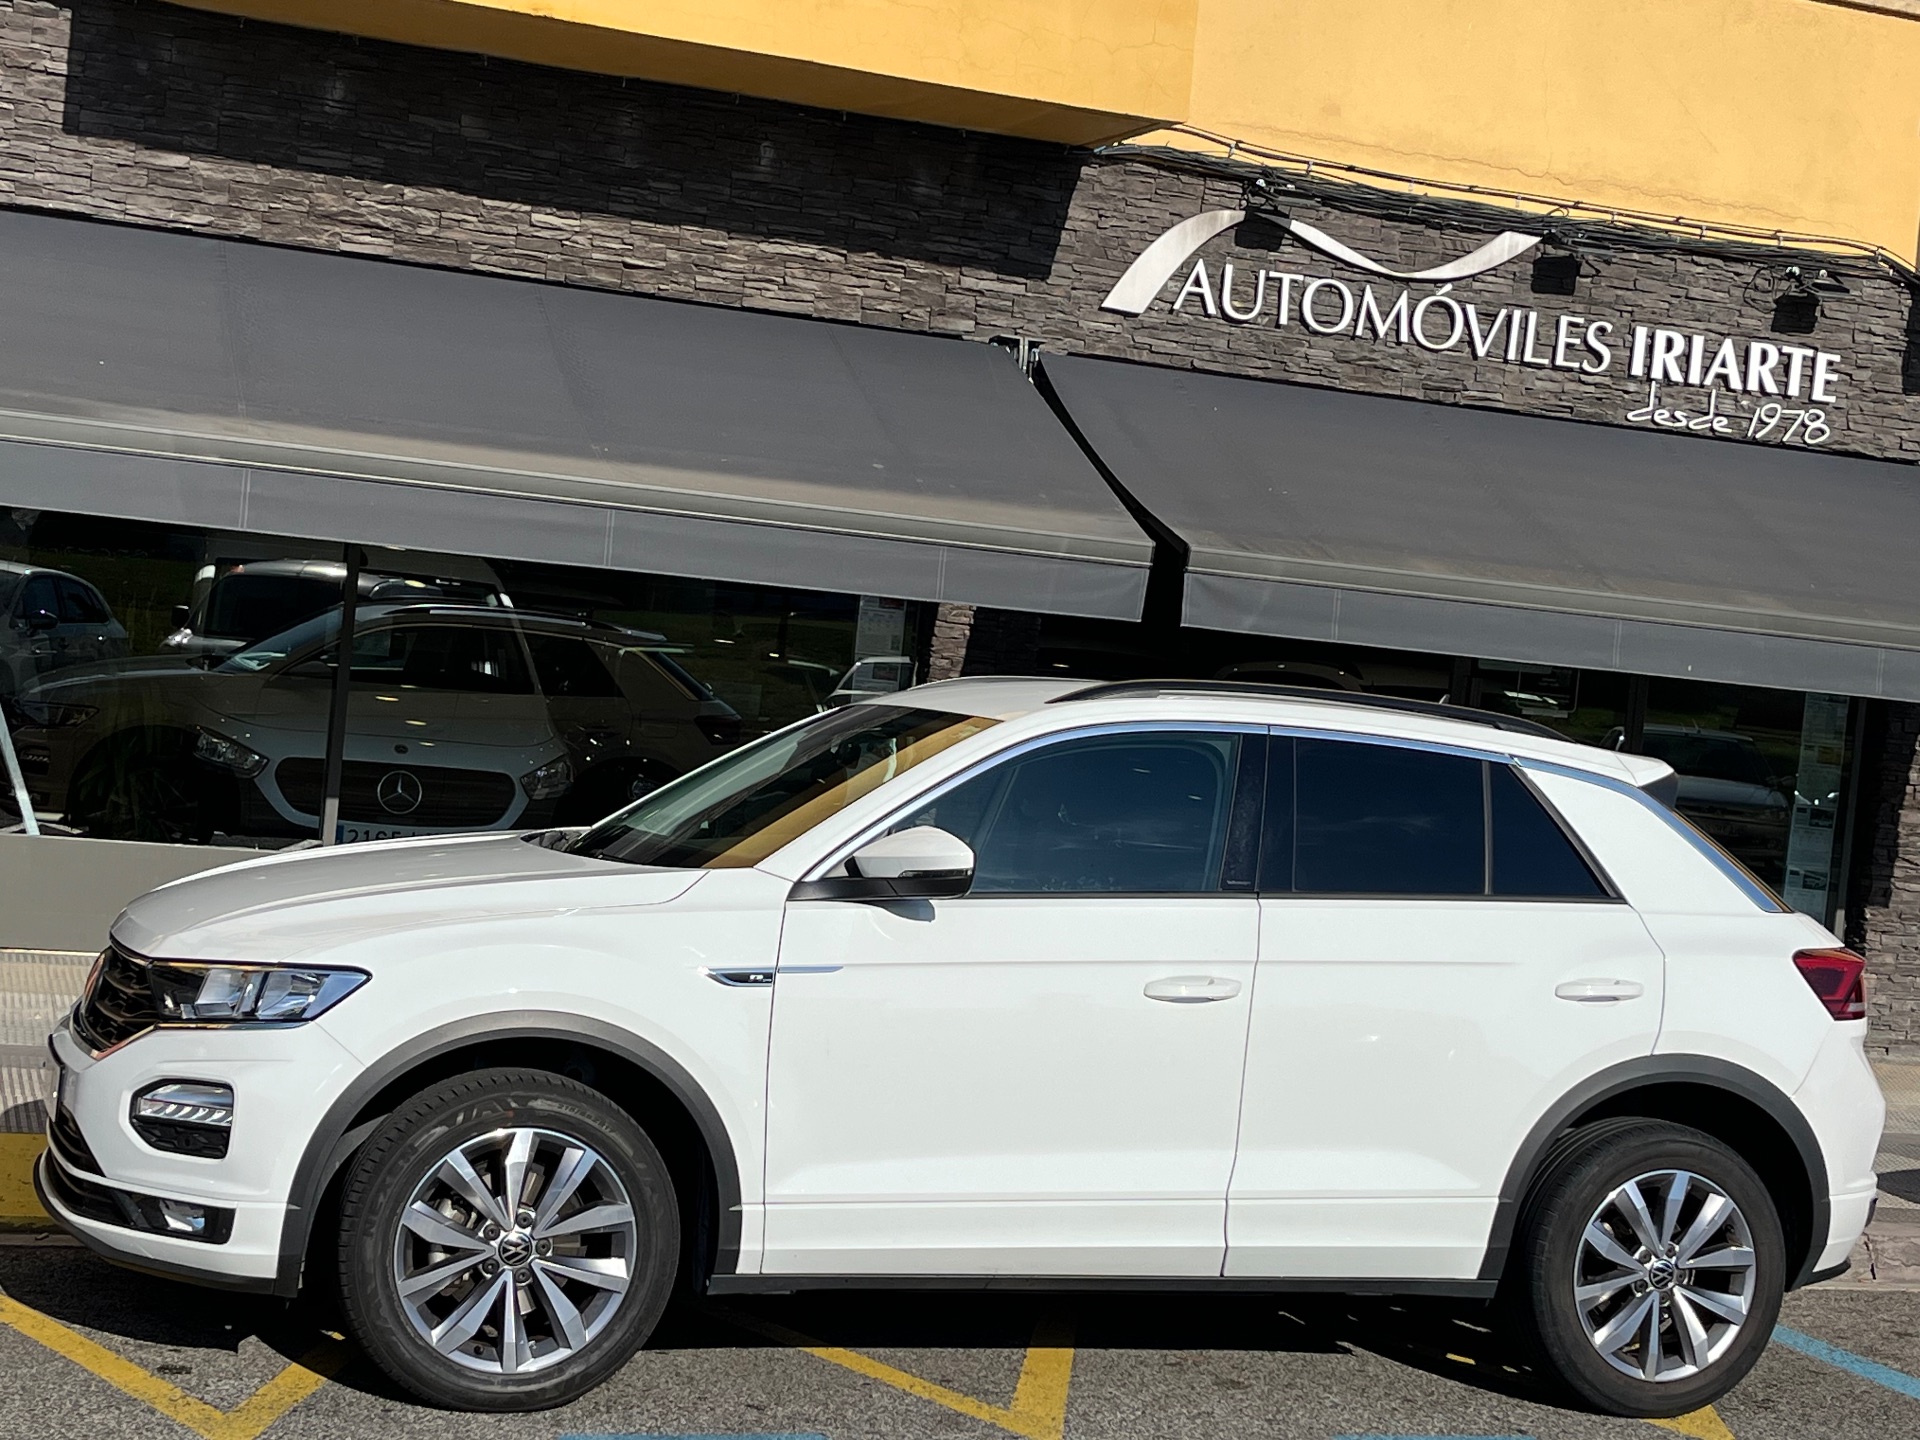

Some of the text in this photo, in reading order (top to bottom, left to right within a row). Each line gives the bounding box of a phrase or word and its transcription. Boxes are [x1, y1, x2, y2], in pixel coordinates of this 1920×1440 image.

[1173, 258, 1842, 404] AUTOMÓVILES IRIARTE
[1626, 380, 1830, 445] desde 1978
